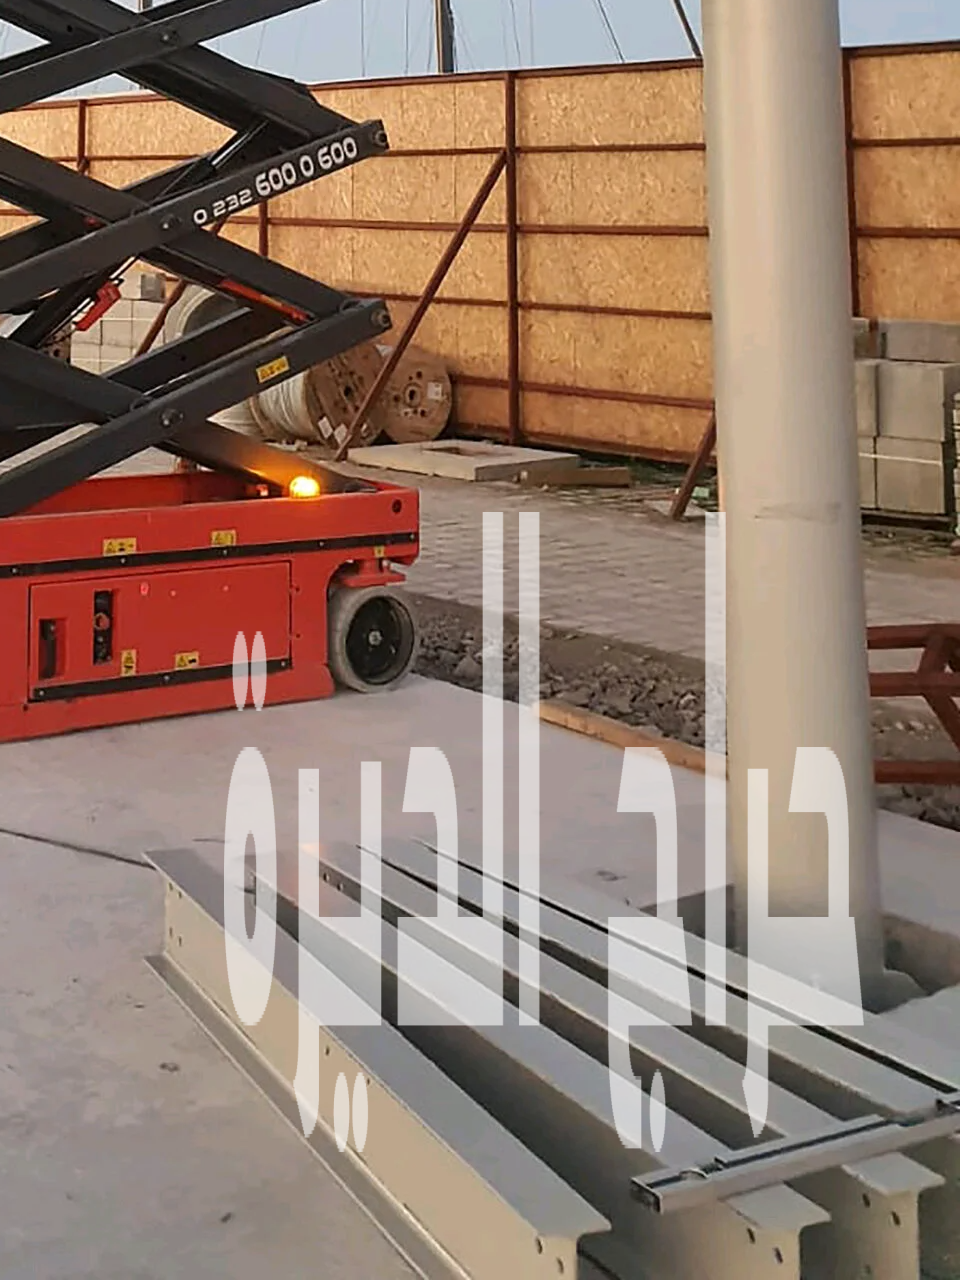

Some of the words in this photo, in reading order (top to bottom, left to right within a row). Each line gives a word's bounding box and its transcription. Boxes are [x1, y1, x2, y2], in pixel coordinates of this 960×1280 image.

[212, 189, 253, 217] 232
[255, 162, 297, 196] 600
[299, 155, 315, 177] 0
[318, 136, 358, 170] 600
